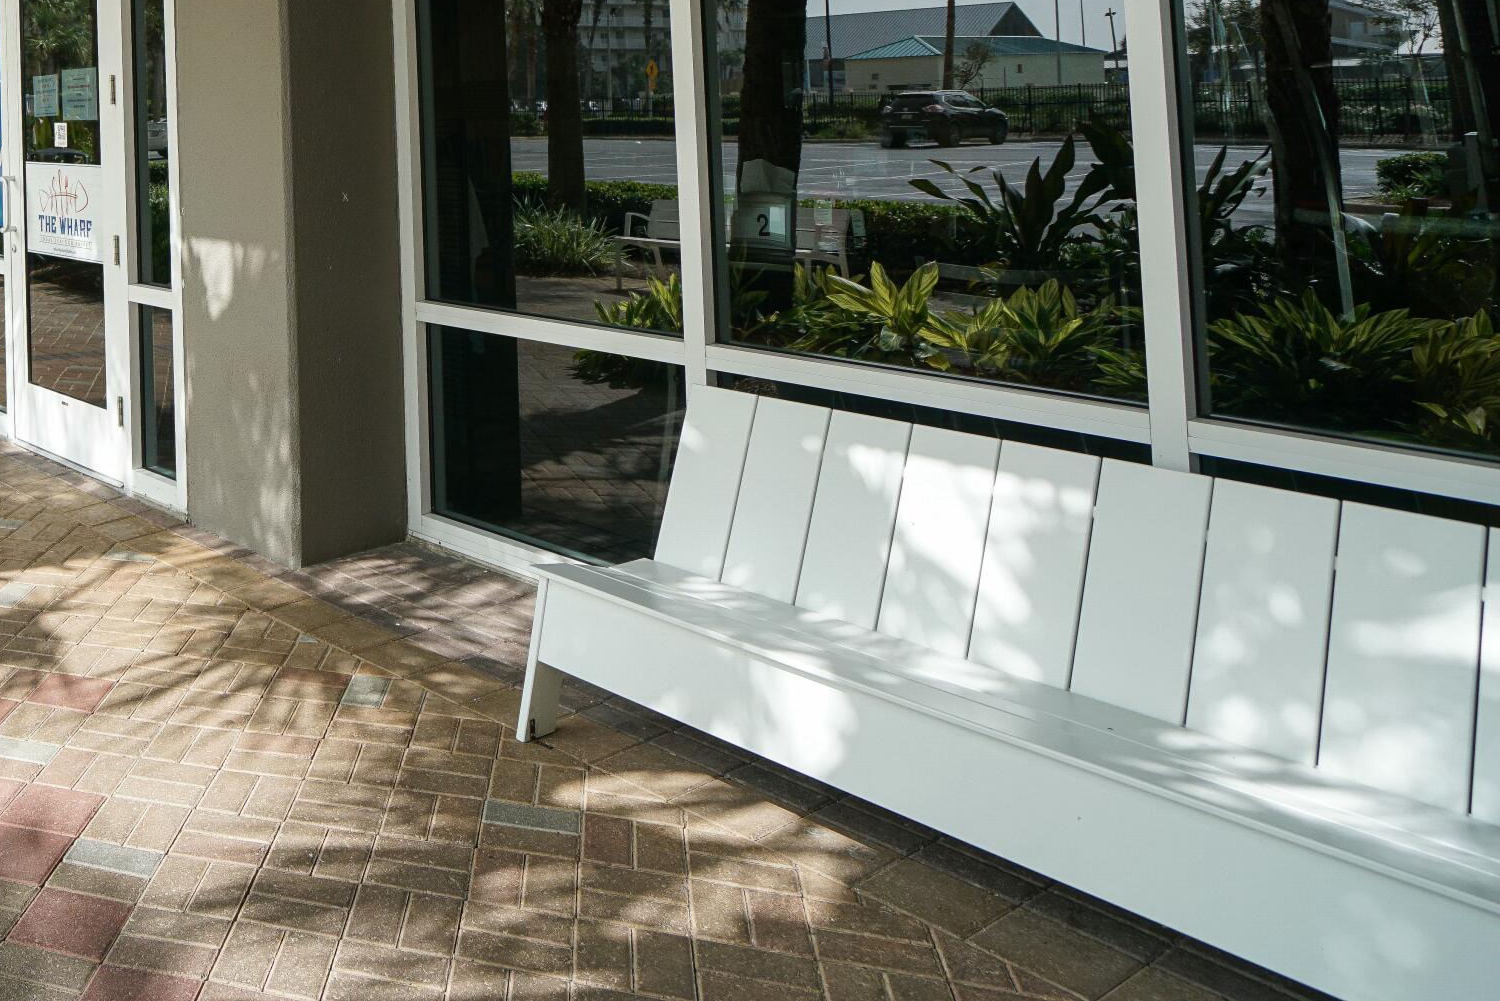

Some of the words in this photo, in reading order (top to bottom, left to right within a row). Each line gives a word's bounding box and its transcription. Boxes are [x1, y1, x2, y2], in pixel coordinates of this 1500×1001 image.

[38, 214, 57, 234] THE
[58, 215, 93, 238] WHARF
[756, 213, 771, 237] 2
